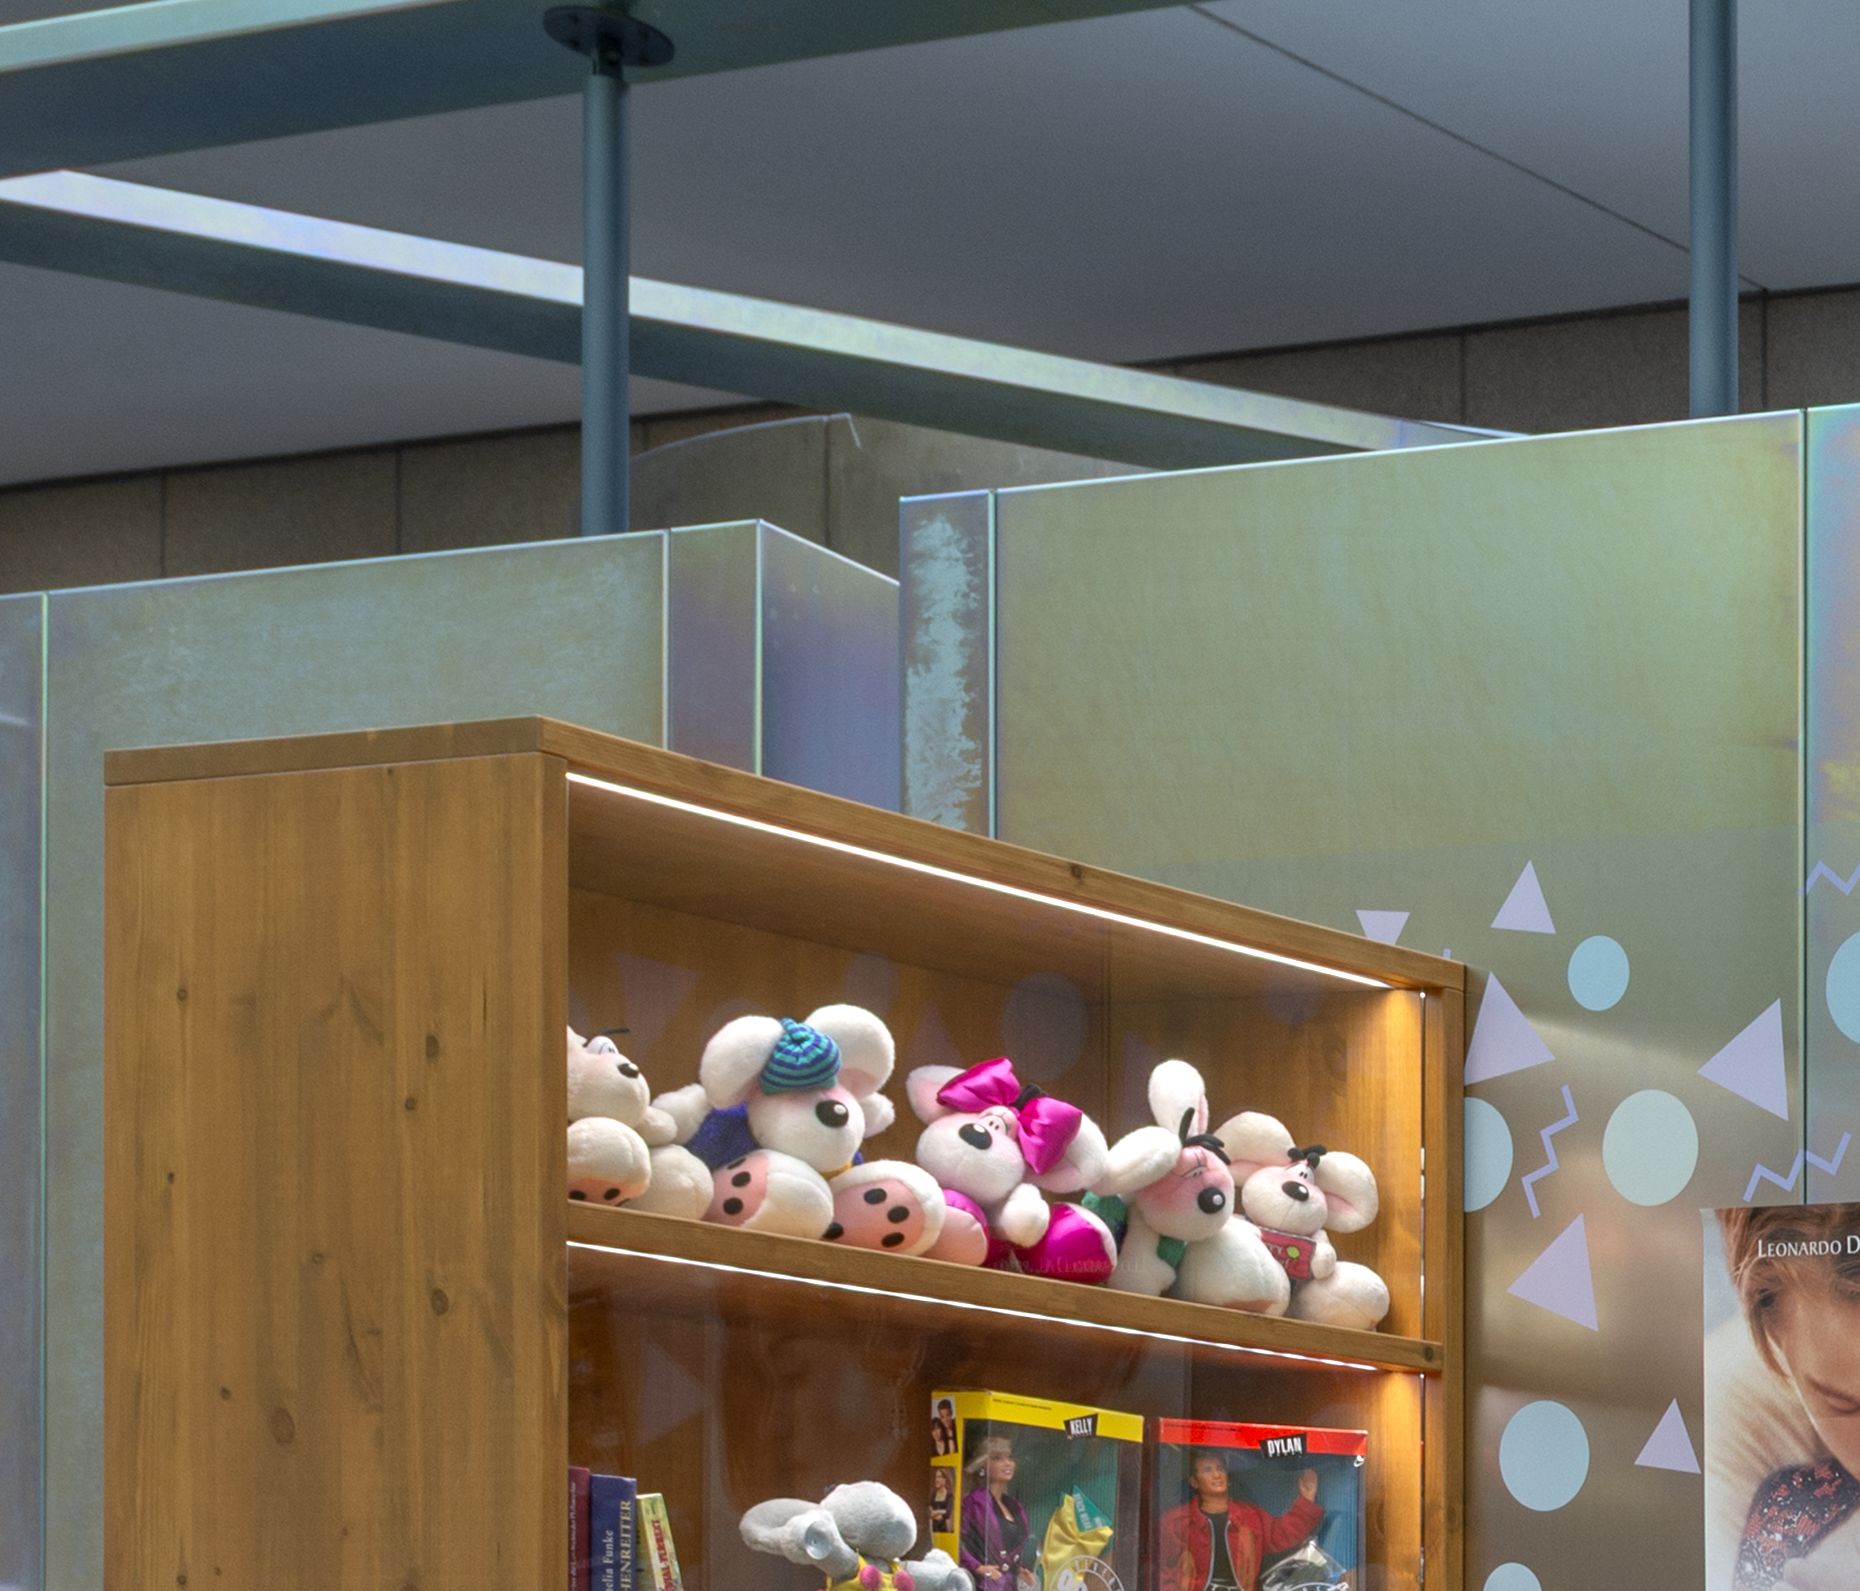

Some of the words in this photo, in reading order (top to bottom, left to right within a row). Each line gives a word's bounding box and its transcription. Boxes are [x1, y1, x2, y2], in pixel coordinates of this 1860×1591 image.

[1757, 1236, 1841, 1258] LEONARDO
[1069, 1417, 1094, 1436] KELLY
[1266, 1437, 1302, 1458] DYLAN
[601, 1530, 613, 1564] Funke
